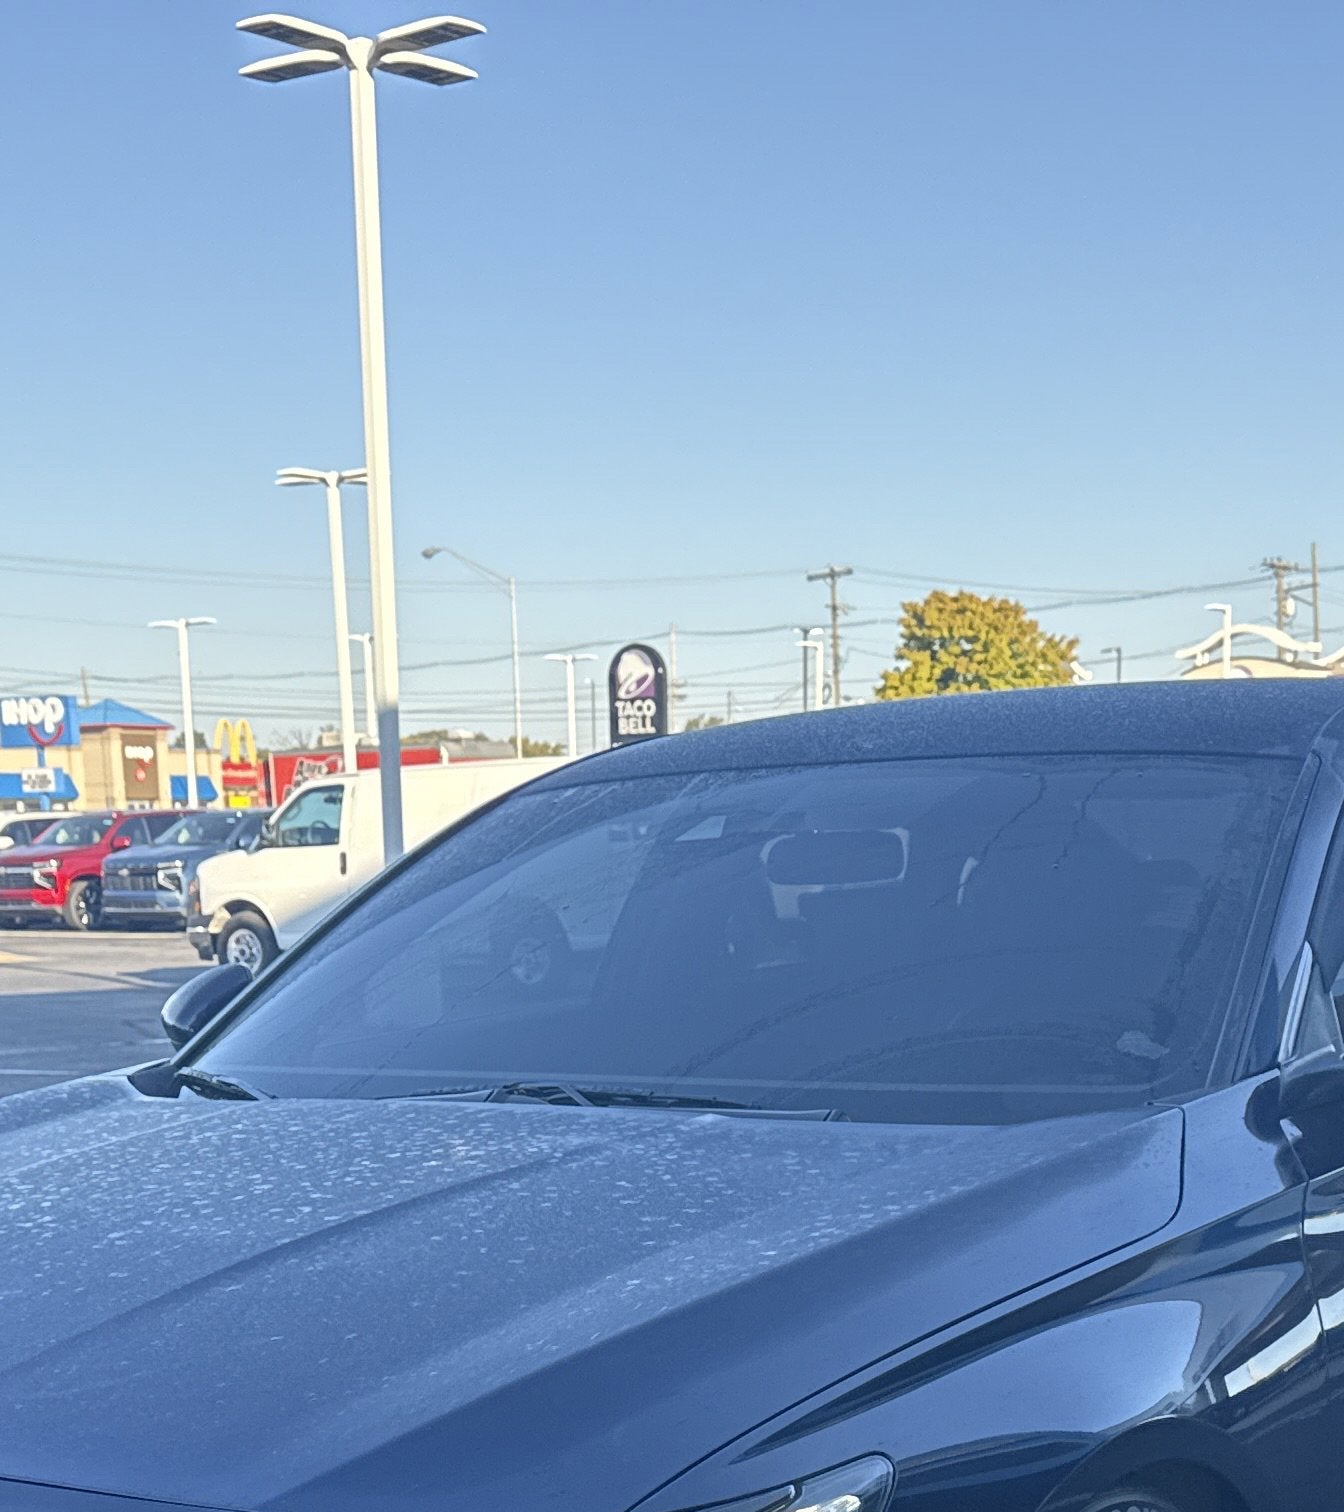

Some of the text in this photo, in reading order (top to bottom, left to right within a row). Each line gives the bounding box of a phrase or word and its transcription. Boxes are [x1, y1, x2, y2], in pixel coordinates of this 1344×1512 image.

[1, 697, 64, 733] IHOP
[615, 699, 656, 718] TACO
[618, 717, 656, 734] BELL
